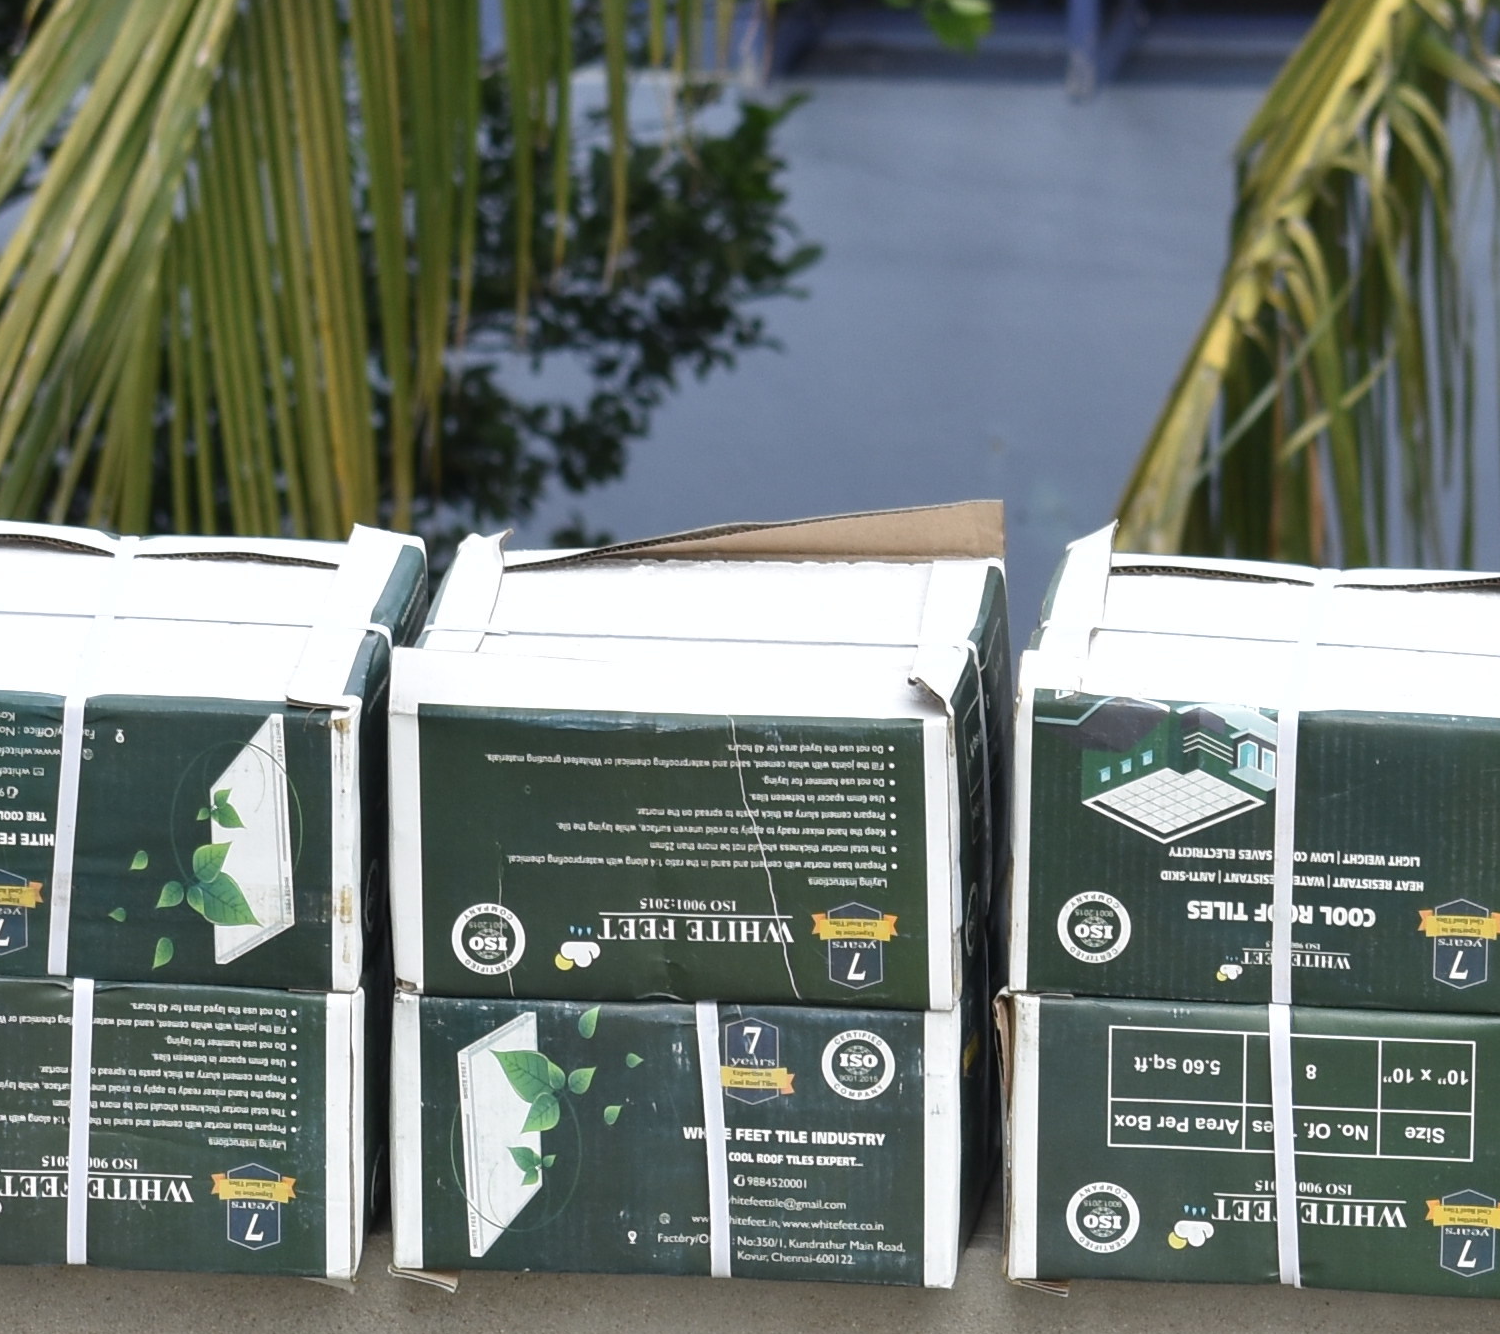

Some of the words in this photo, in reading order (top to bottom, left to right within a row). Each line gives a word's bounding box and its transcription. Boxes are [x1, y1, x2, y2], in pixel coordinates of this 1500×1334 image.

[762, 776, 789, 786] laying.
[791, 778, 803, 786] for
[804, 778, 839, 787] hammer
[857, 778, 871, 786] not
[872, 778, 885, 787] Do
[749, 793, 769, 802] tiles.
[770, 794, 805, 803] between
[806, 794, 815, 803] in
[817, 793, 845, 802] spacer
[846, 795, 867, 804] 6mm
[869, 794, 885, 804] Use
[26, 811, 47, 822] THE
[1168, 846, 1236, 859] ELECTRICITY
[1238, 848, 1272, 862] SAVES
[507, 855, 545, 864] chemical.
[547, 855, 604, 865] waterproofing
[606, 857, 623, 866] with
[625, 856, 649, 866] along
[650, 858, 663, 867] 1:4
[665, 858, 684, 867] ratio
[686, 859, 699, 867] the
[711, 860, 731, 868] sand
[733, 860, 749, 868] and
[750, 859, 782, 868] cement
[784, 861, 802, 869] with
[803, 861, 831, 869] mortar
[832, 861, 853, 870] base
[854, 860, 887, 871] Prepare
[808, 877, 857, 888] instructions
[858, 877, 888, 888] Laying
[639, 896, 706, 910] 9001:2015
[710, 899, 737, 911] ISO
[462, 903, 513, 920] COMPANY
[1187, 900, 1248, 920] TILES
[1319, 906, 1376, 928] COOL
[597, 917, 675, 940] FEET
[686, 919, 794, 943] WHITE
[1075, 924, 1114, 940] ISO
[469, 936, 508, 951] ISO
[832, 939, 878, 950] years
[1438, 937, 1483, 948] years
[464, 958, 513, 974] CERTIFIED
[846, 952, 866, 980] 7
[1291, 954, 1351, 970] WHITE
[1450, 951, 1469, 978] 7
[742, 1026, 760, 1054] 7
[834, 1032, 883, 1046] CERTIFIED
[730, 1056, 776, 1068] years
[839, 1053, 878, 1068] ISO
[1134, 1054, 1176, 1074] sq.ft
[1182, 1058, 1221, 1076] 5.60
[1305, 1063, 1317, 1080] 8
[833, 1083, 884, 1098] COMPANY
[1114, 1114, 1151, 1131] Box
[1157, 1115, 1189, 1133] Per
[1195, 1116, 1239, 1134] Area
[1303, 1122, 1331, 1138] Of.
[1337, 1123, 1369, 1140] No.
[1405, 1126, 1445, 1143] Size
[735, 1128, 772, 1142] FEET
[775, 1130, 808, 1144] TILE
[811, 1131, 886, 1146] INDUSTRY
[726, 1152, 754, 1164] COOL
[756, 1153, 784, 1164] ROOF
[785, 1154, 814, 1166] TILES
[816, 1155, 863, 1167] EXPERT...
[744, 1176, 807, 1189] 9884520001
[88, 1176, 194, 1203] WHITE
[1325, 1183, 1352, 1196] ISO
[1300, 1201, 1407, 1228] WHITE
[245, 1214, 264, 1240] 7
[781, 1219, 884, 1231] www.whitefeet.co.in
[1084, 1214, 1122, 1229] ISO
[1445, 1227, 1490, 1238] years
[1457, 1239, 1478, 1268] 7
